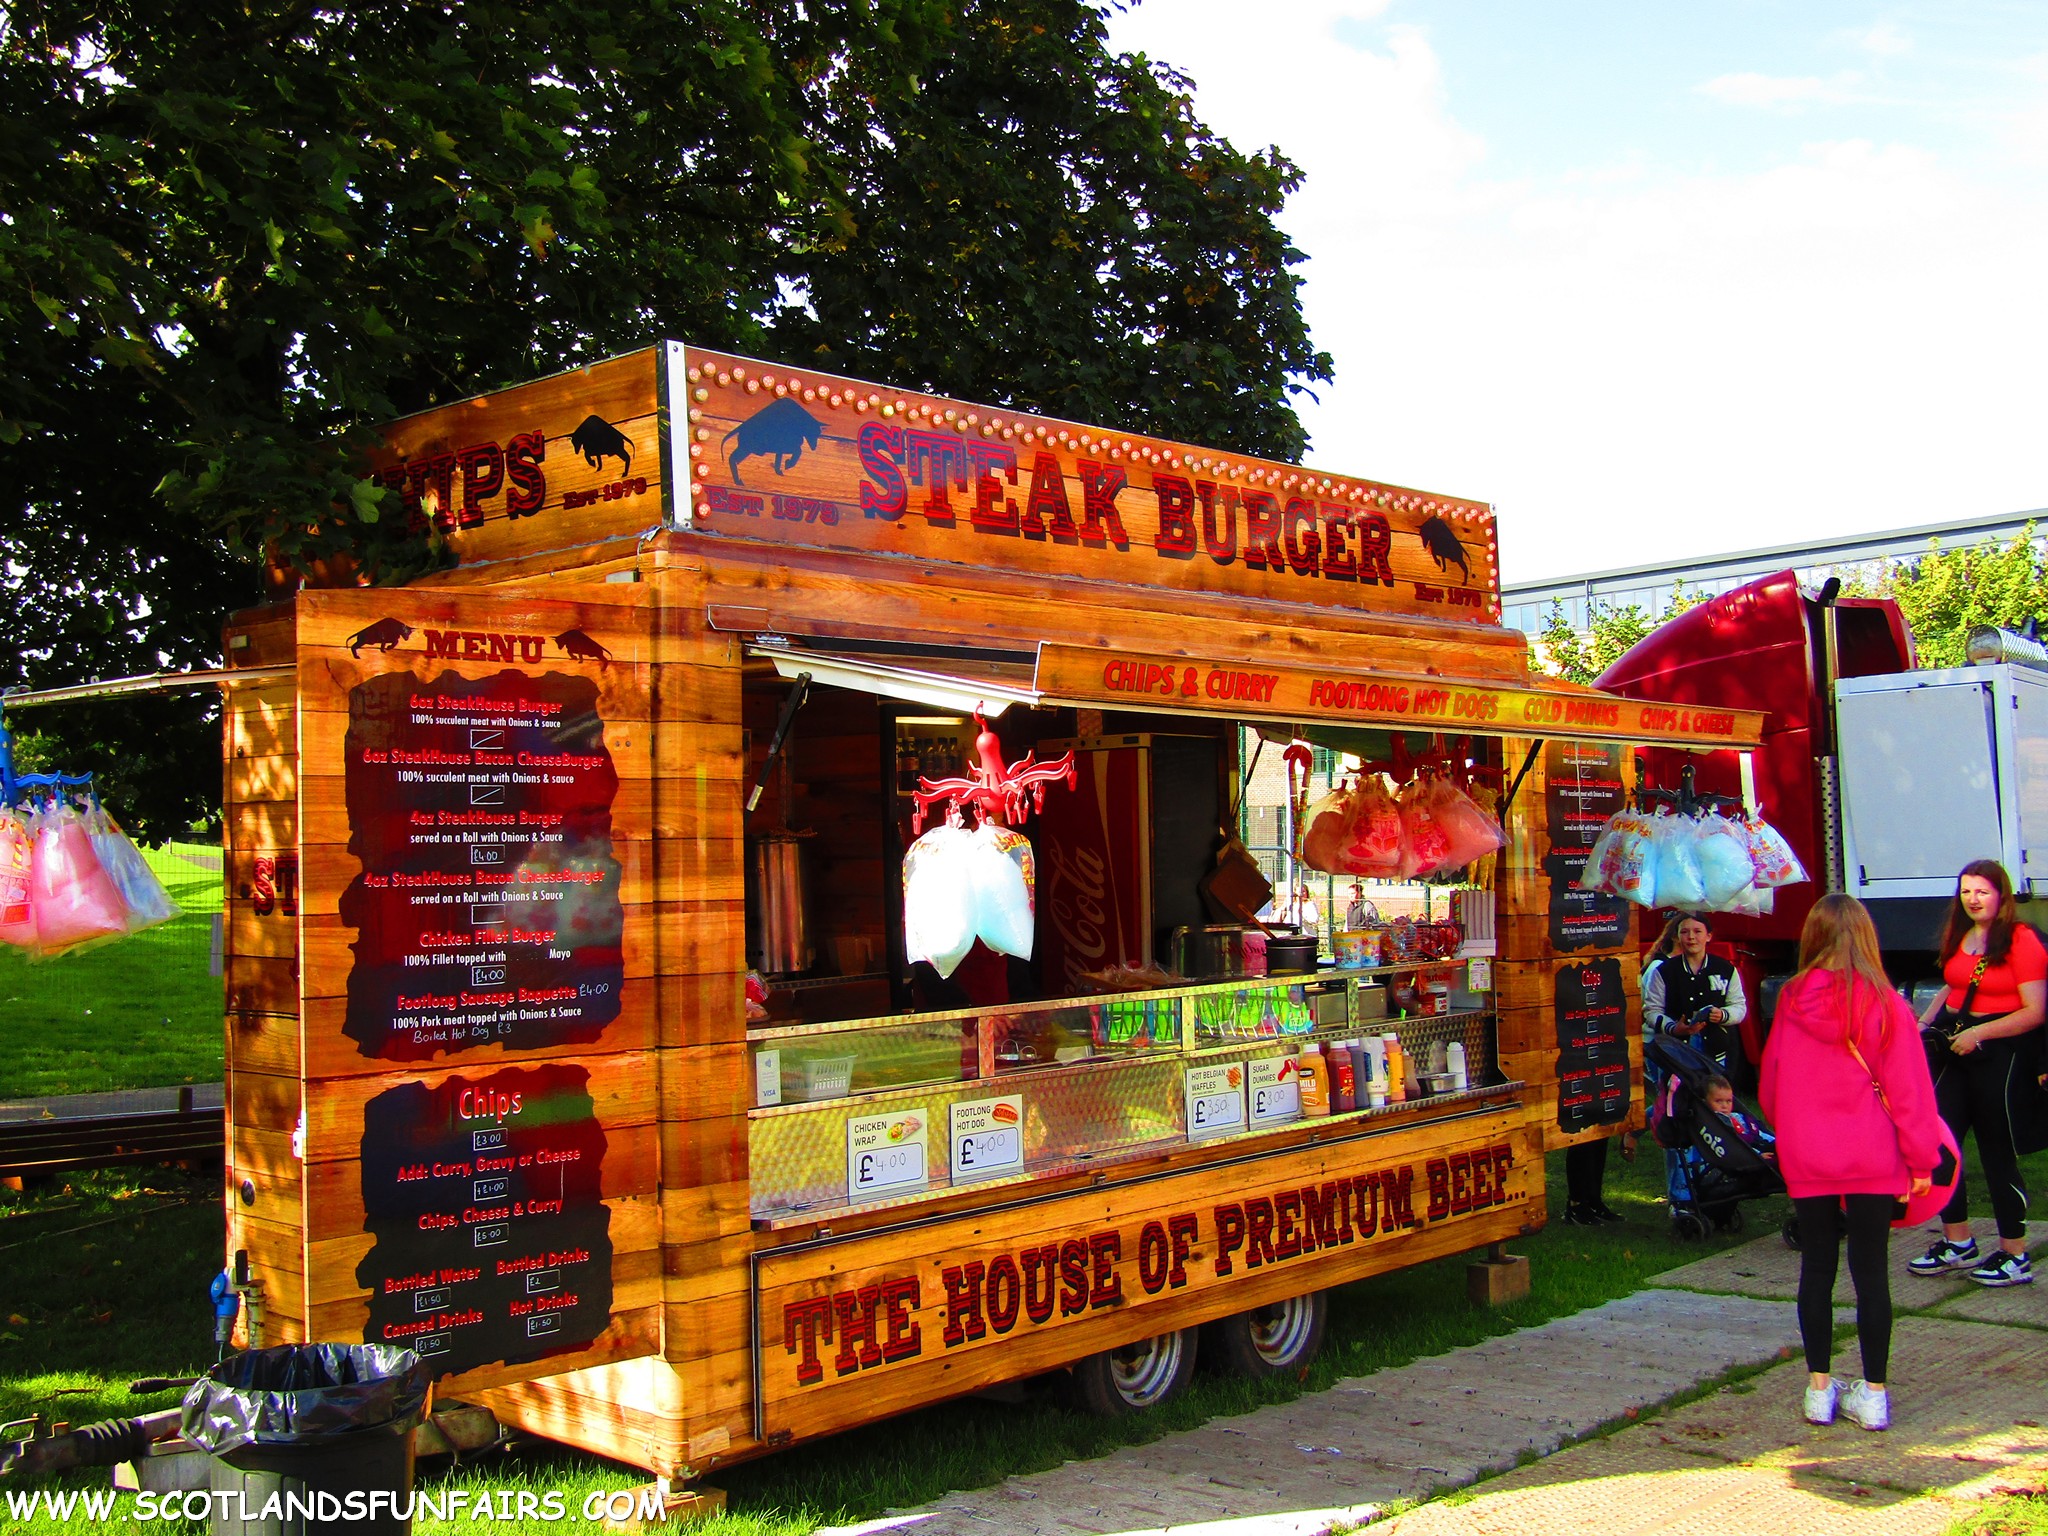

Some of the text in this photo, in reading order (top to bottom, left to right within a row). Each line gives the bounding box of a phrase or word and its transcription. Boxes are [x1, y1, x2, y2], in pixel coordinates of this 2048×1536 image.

[366, 429, 547, 533] HIPS
[602, 476, 648, 502] 1979
[771, 496, 840, 526] 1979
[857, 420, 1395, 588] STEAK BURGER
[423, 629, 546, 664] MENU
[1103, 659, 1280, 703] CHIPS & CURRY
[410, 693, 563, 717] 6oz SteakHouse Burger
[1309, 678, 1499, 721] FOOTLONG HOT DOGS
[411, 714, 561, 729] 100% succulent meat with Onions & sauce
[1523, 697, 1620, 728] COLD DRINKS
[1639, 707, 1736, 736] CHIPS & CHEESE
[362, 747, 605, 771] 6oz SteakHouse Bacon CheeseBurger
[397, 770, 575, 784] 100% succulent meat with Onions & sauce
[410, 809, 563, 829] 4oz SteakHouse Burger
[410, 831, 564, 843] served on a Roll with Onions & Sauce
[363, 867, 606, 888] 4oz SteakHouse Bacon CheeseBurger
[410, 889, 564, 905] served on a Roll with Onions & Sauce
[420, 927, 557, 948] Chicken Fillet Burger
[403, 948, 571, 967] 100% Fillet topped with Mayo
[1708, 974, 1728, 996] NY
[397, 985, 578, 1011] Footlong Sausage Baguette
[392, 1006, 582, 1030] 100% Pork meat topped with Onions & Sauce
[413, 1029, 449, 1044] Boiled
[451, 1028, 467, 1040] Hot
[471, 1026, 490, 1040] Dog
[1191, 1069, 1226, 1081] HOT BELGIAN
[1252, 1064, 1270, 1074] SUGAR
[1252, 1073, 1277, 1084] DUMMIES
[1191, 1081, 1217, 1092] WAFFLES
[458, 1086, 524, 1124] Chips
[956, 1105, 991, 1118] FOOTLONG
[854, 1121, 888, 1134] CHICKEN
[956, 1119, 986, 1131] HOT DOG
[854, 1135, 877, 1147] WRAP
[396, 1147, 581, 1183] Add: Curry, Gravy or Cheese
[418, 1198, 564, 1231] Chips, Cheese & Curry
[496, 1247, 591, 1276] Bottled Drinks
[384, 1266, 482, 1294] Bottled Water
[783, 1274, 922, 1386] THE
[942, 1229, 1125, 1348] HOUSE
[1139, 1211, 1199, 1295] OF
[1213, 1164, 1415, 1278] PREMIUM
[509, 1291, 580, 1317] Hot Drinks
[383, 1307, 485, 1340] Canned Drinks
